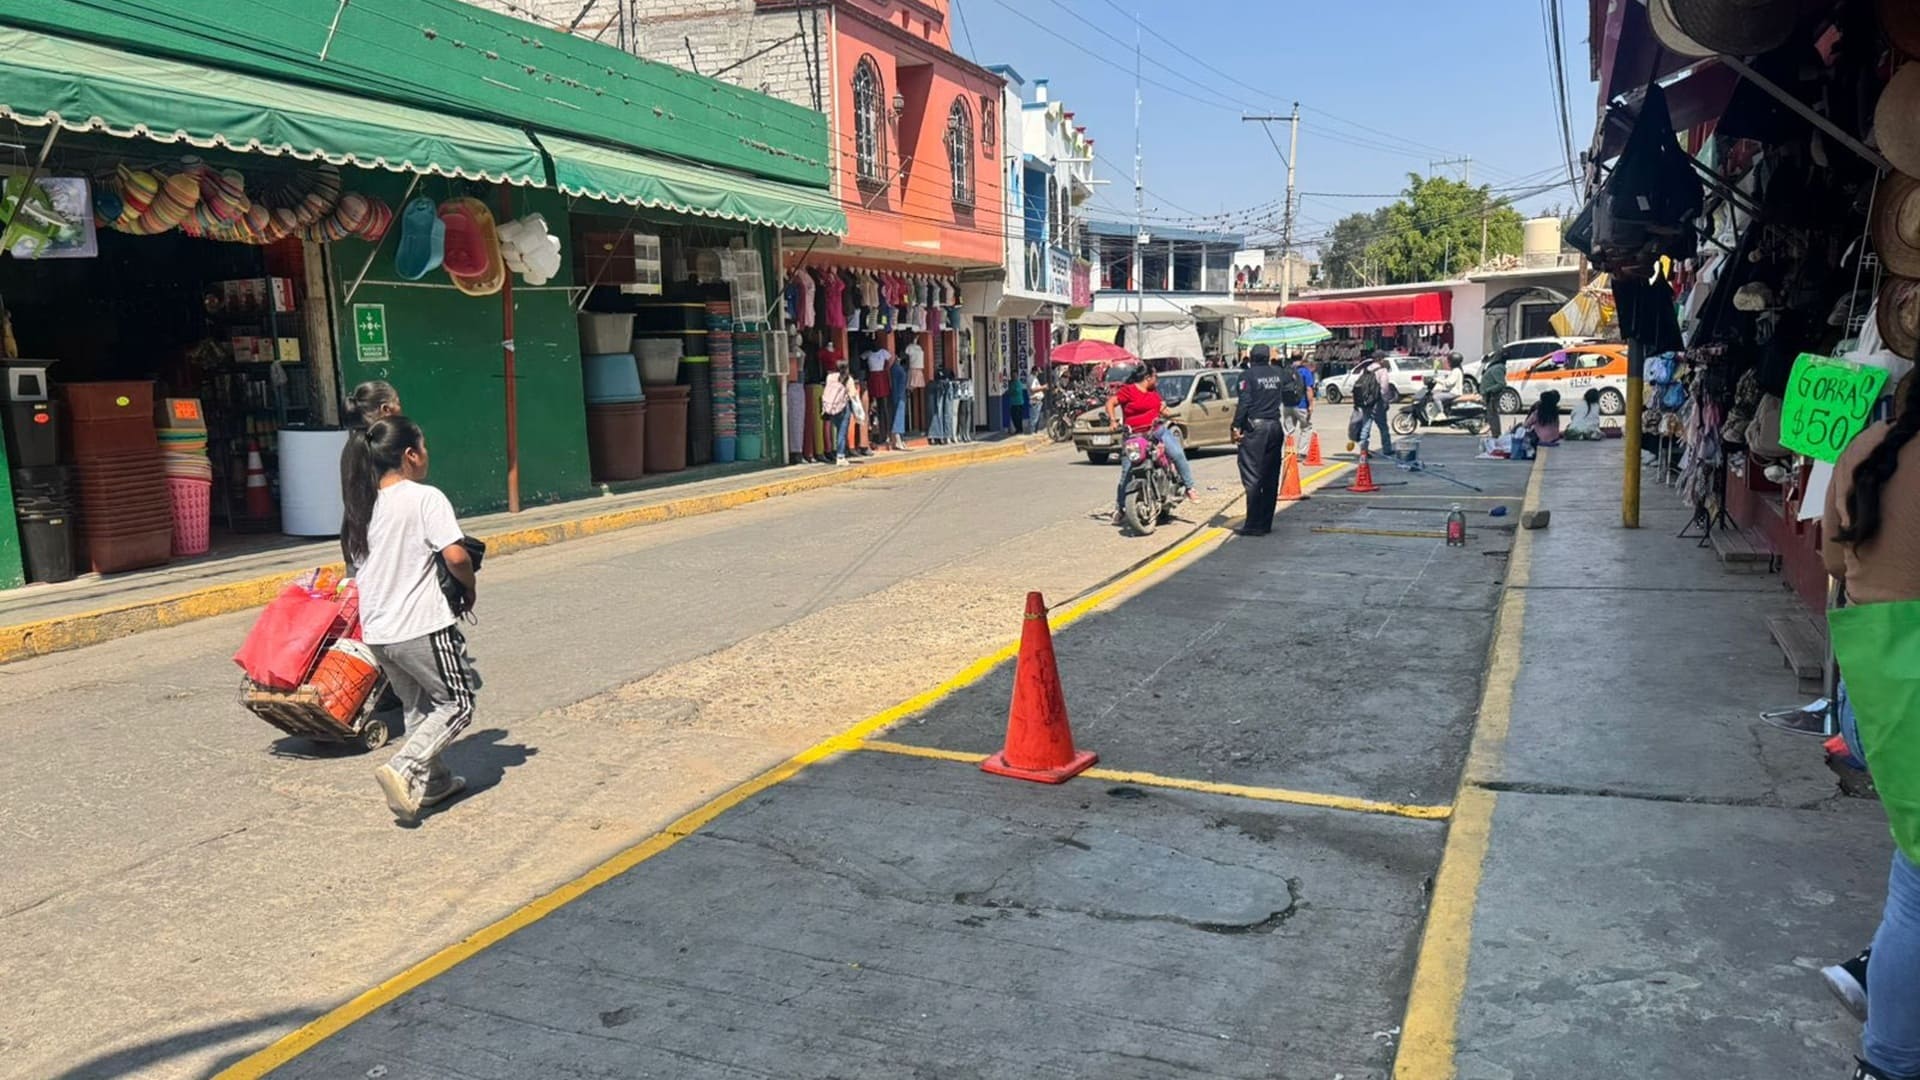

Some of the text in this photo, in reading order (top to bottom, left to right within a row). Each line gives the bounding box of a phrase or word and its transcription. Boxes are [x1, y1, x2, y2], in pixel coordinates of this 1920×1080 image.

[1001, 321, 1009, 389] COPIAS
[1798, 365, 1875, 420] GORRAS
[1791, 404, 1849, 451] $50
